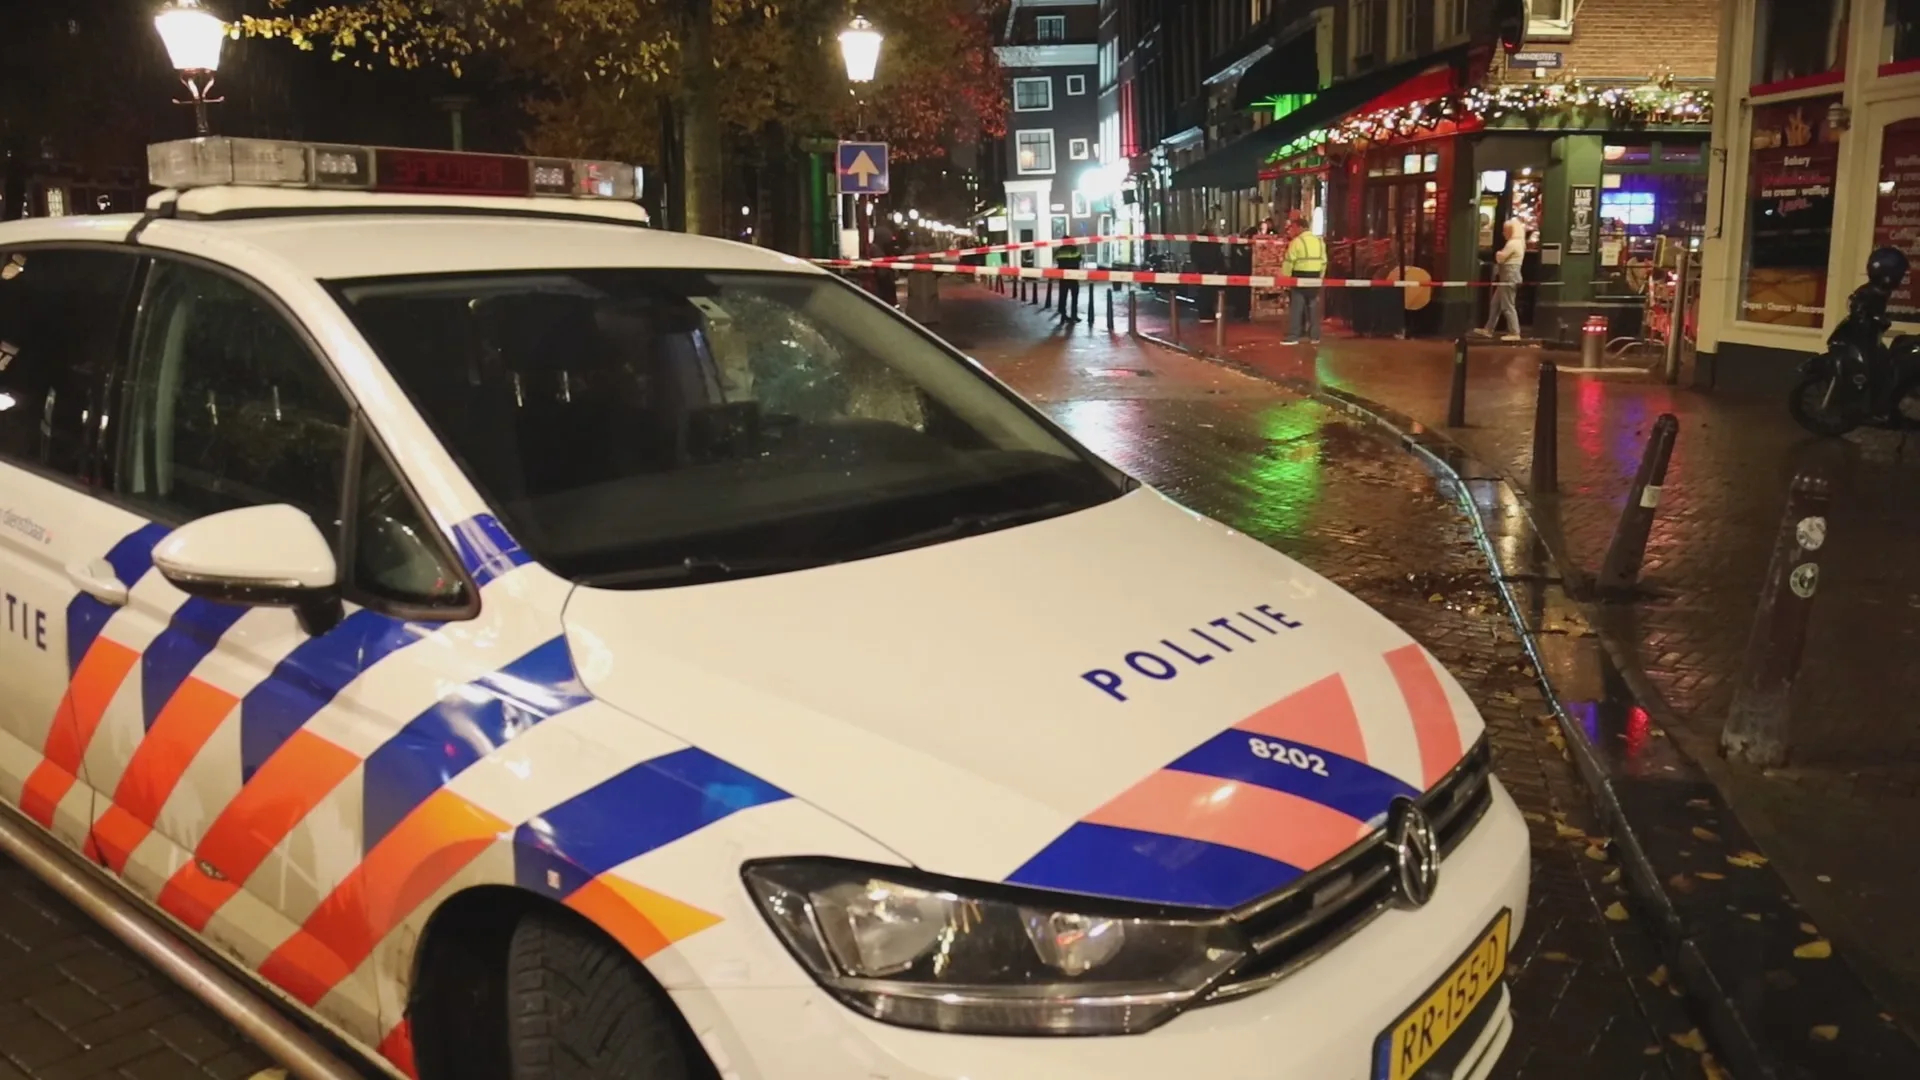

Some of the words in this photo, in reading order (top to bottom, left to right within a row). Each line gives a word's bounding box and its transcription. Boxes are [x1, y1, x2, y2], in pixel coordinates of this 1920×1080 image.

[1783, 156, 1811, 167] Bakery
[1079, 604, 1304, 703] POLITIE
[1248, 737, 1330, 778] 8202
[1401, 934, 1499, 1076] RR-155-D
